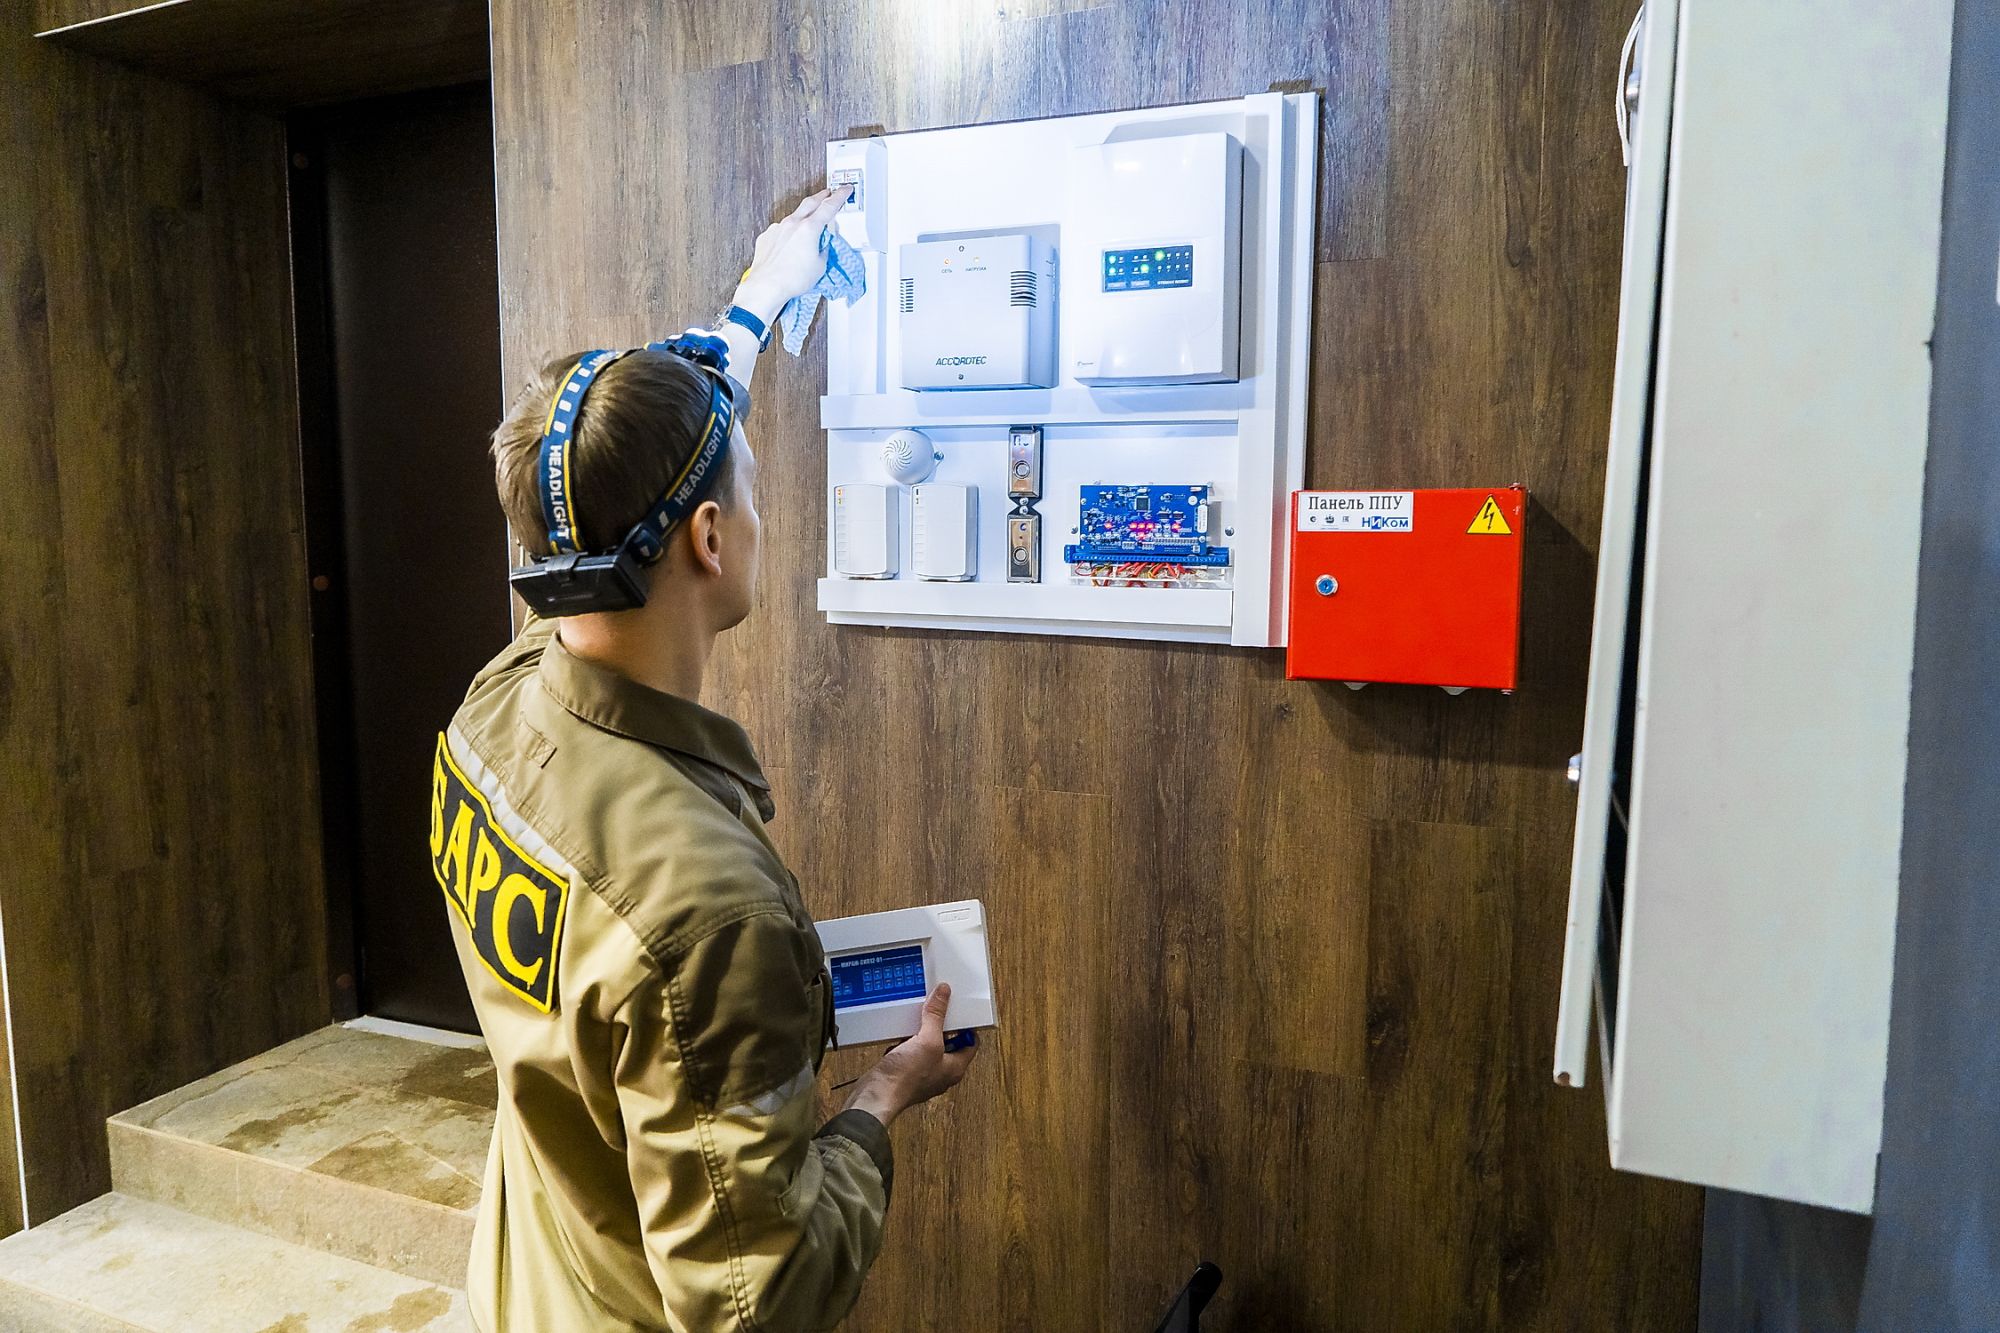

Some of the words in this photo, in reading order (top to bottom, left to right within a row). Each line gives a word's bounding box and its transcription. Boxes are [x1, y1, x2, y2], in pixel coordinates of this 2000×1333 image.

[936, 356, 987, 366] ACCORDTEC
[674, 427, 723, 507] HEADLIGHT
[548, 444, 570, 541] HEADLIGHT
[1308, 495, 1364, 510] Панель
[1368, 495, 1403, 510] ППУ
